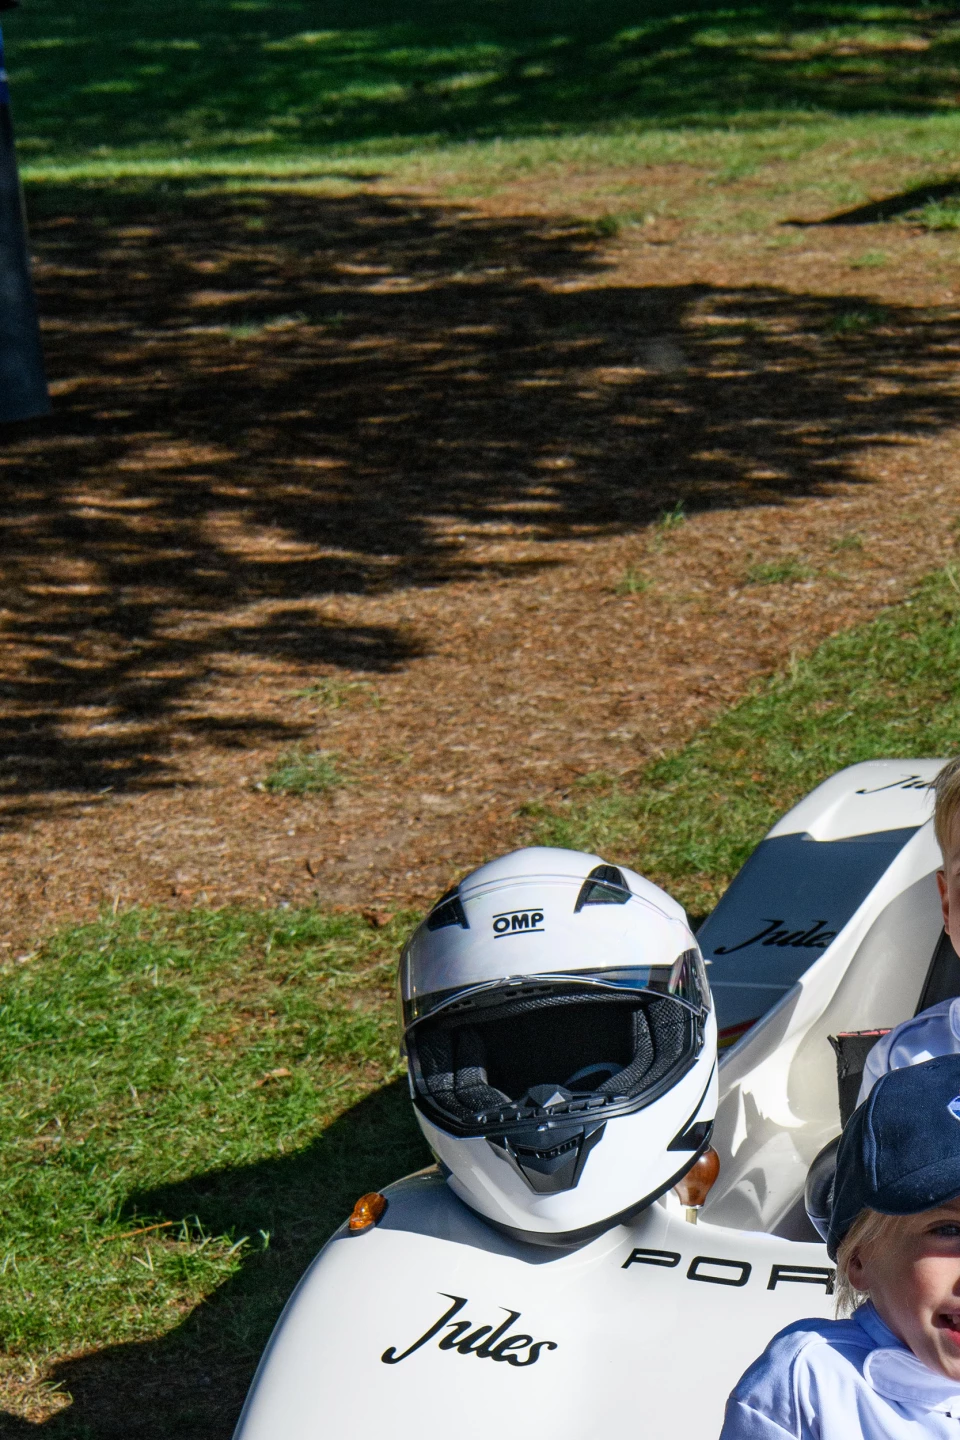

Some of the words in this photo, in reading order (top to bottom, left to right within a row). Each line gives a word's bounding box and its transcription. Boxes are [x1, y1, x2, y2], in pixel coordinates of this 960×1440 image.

[492, 911, 545, 934] OMP
[713, 919, 838, 956] Jule
[380, 1291, 558, 1367] Jules
